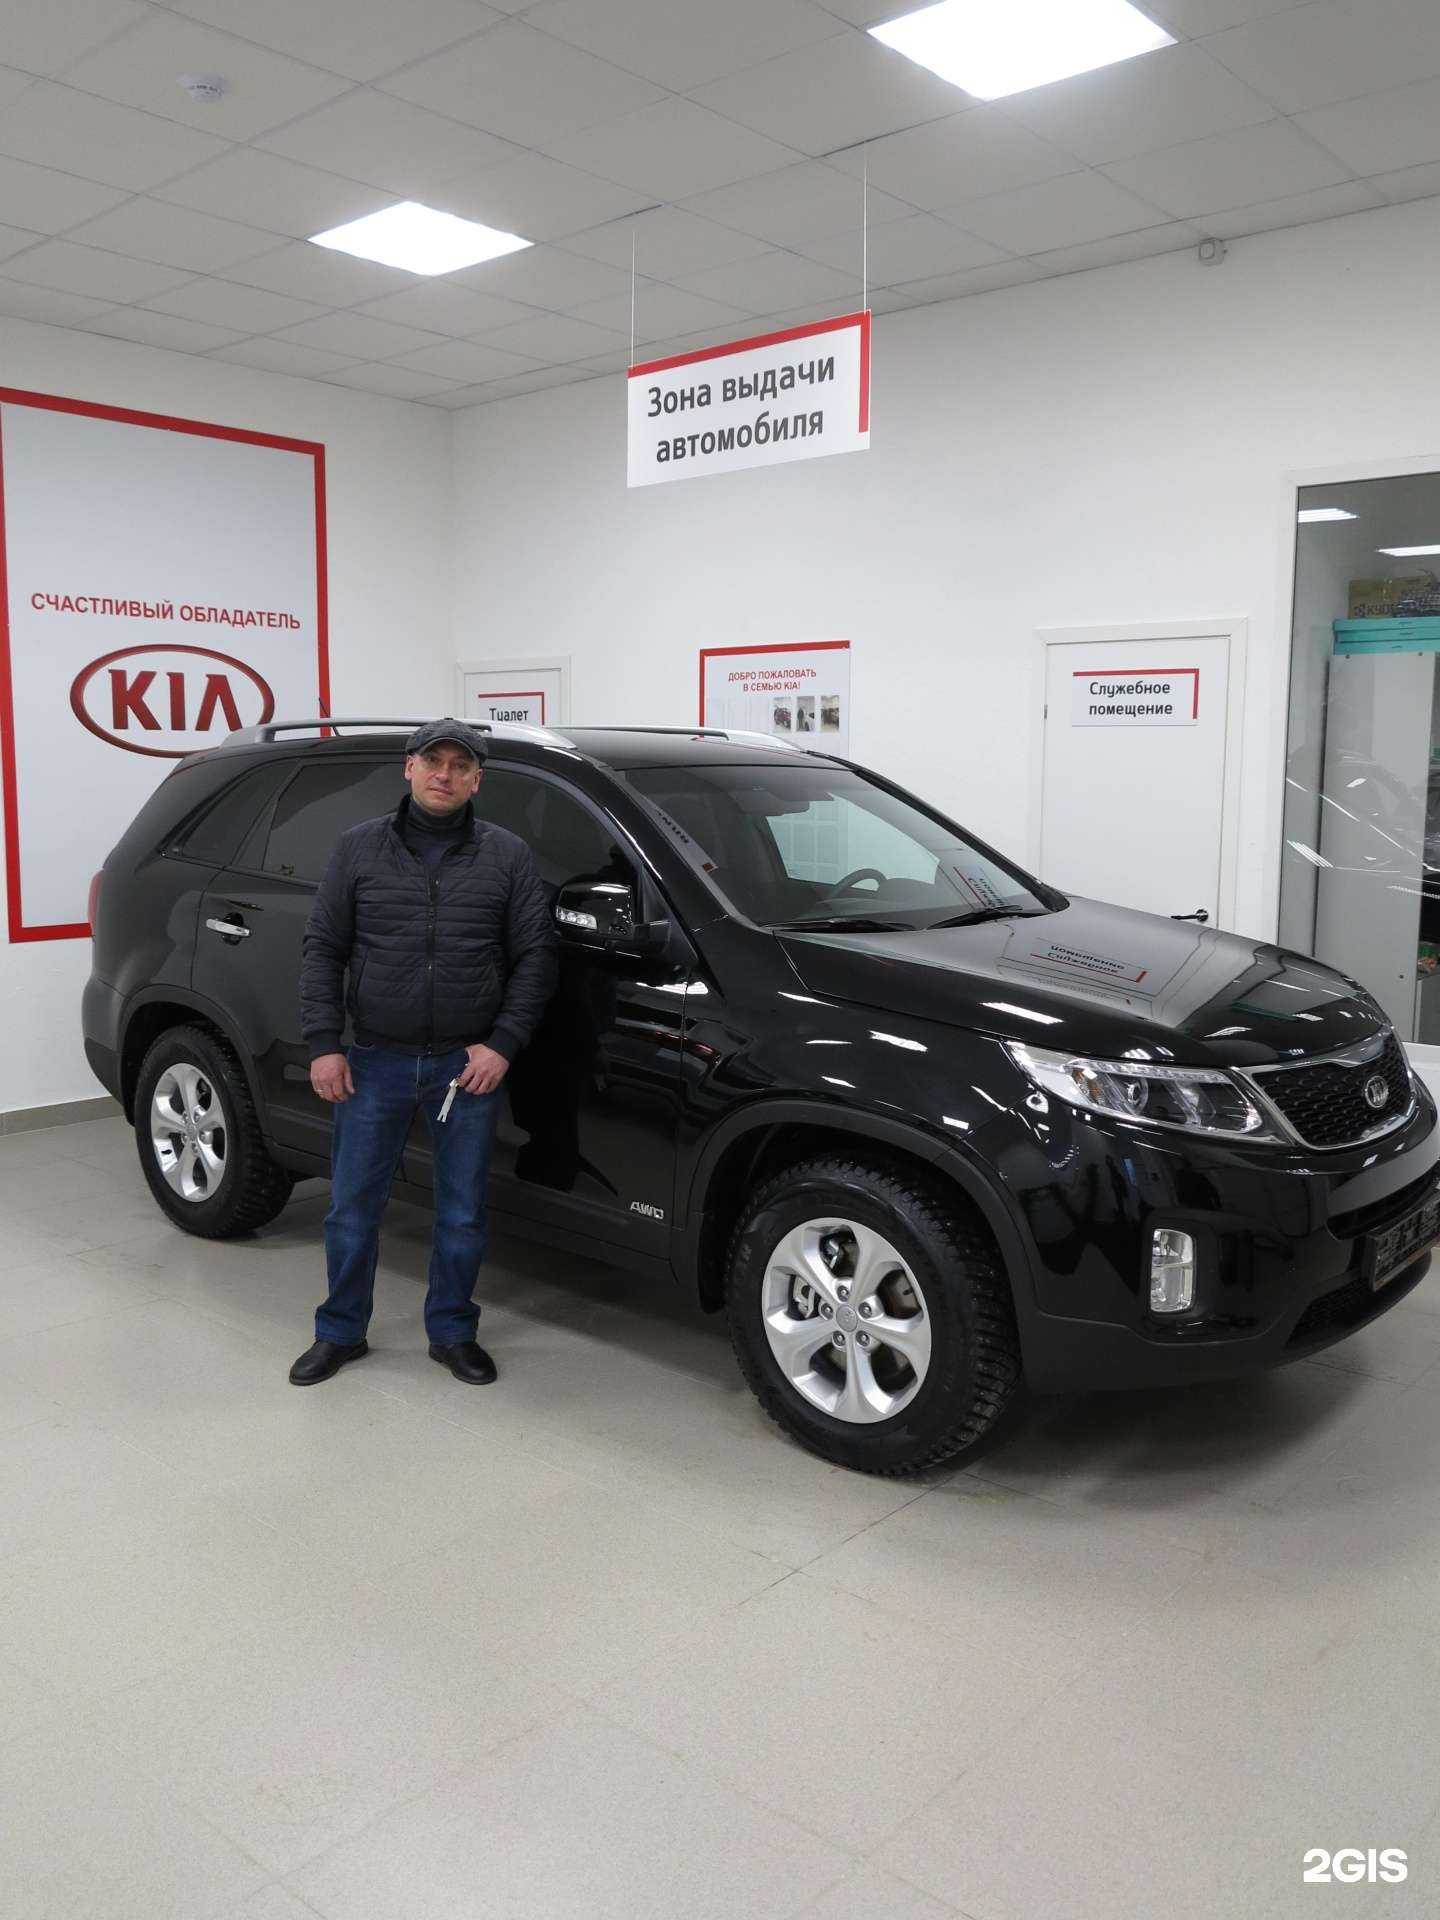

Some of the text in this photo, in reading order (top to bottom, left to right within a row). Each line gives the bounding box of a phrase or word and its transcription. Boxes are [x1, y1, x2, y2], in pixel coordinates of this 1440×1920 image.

[647, 356, 835, 418] Зона выдачи
[656, 410, 824, 463] автомобиля
[31, 593, 301, 629] СЧАСТЛИВЫЙ ОБЛАДАТЕЛЬ
[728, 669, 817, 682] ДОБРО ПОЖАЛОВАТЬ
[743, 683, 749, 691] В
[751, 682, 782, 691] СЕМЬЮ
[1089, 680, 1171, 698] Служебное
[108, 668, 243, 731] KIA
[488, 707, 529, 721] Туалет
[1089, 704, 1173, 717] помещение
[630, 1201, 664, 1220] AWD
